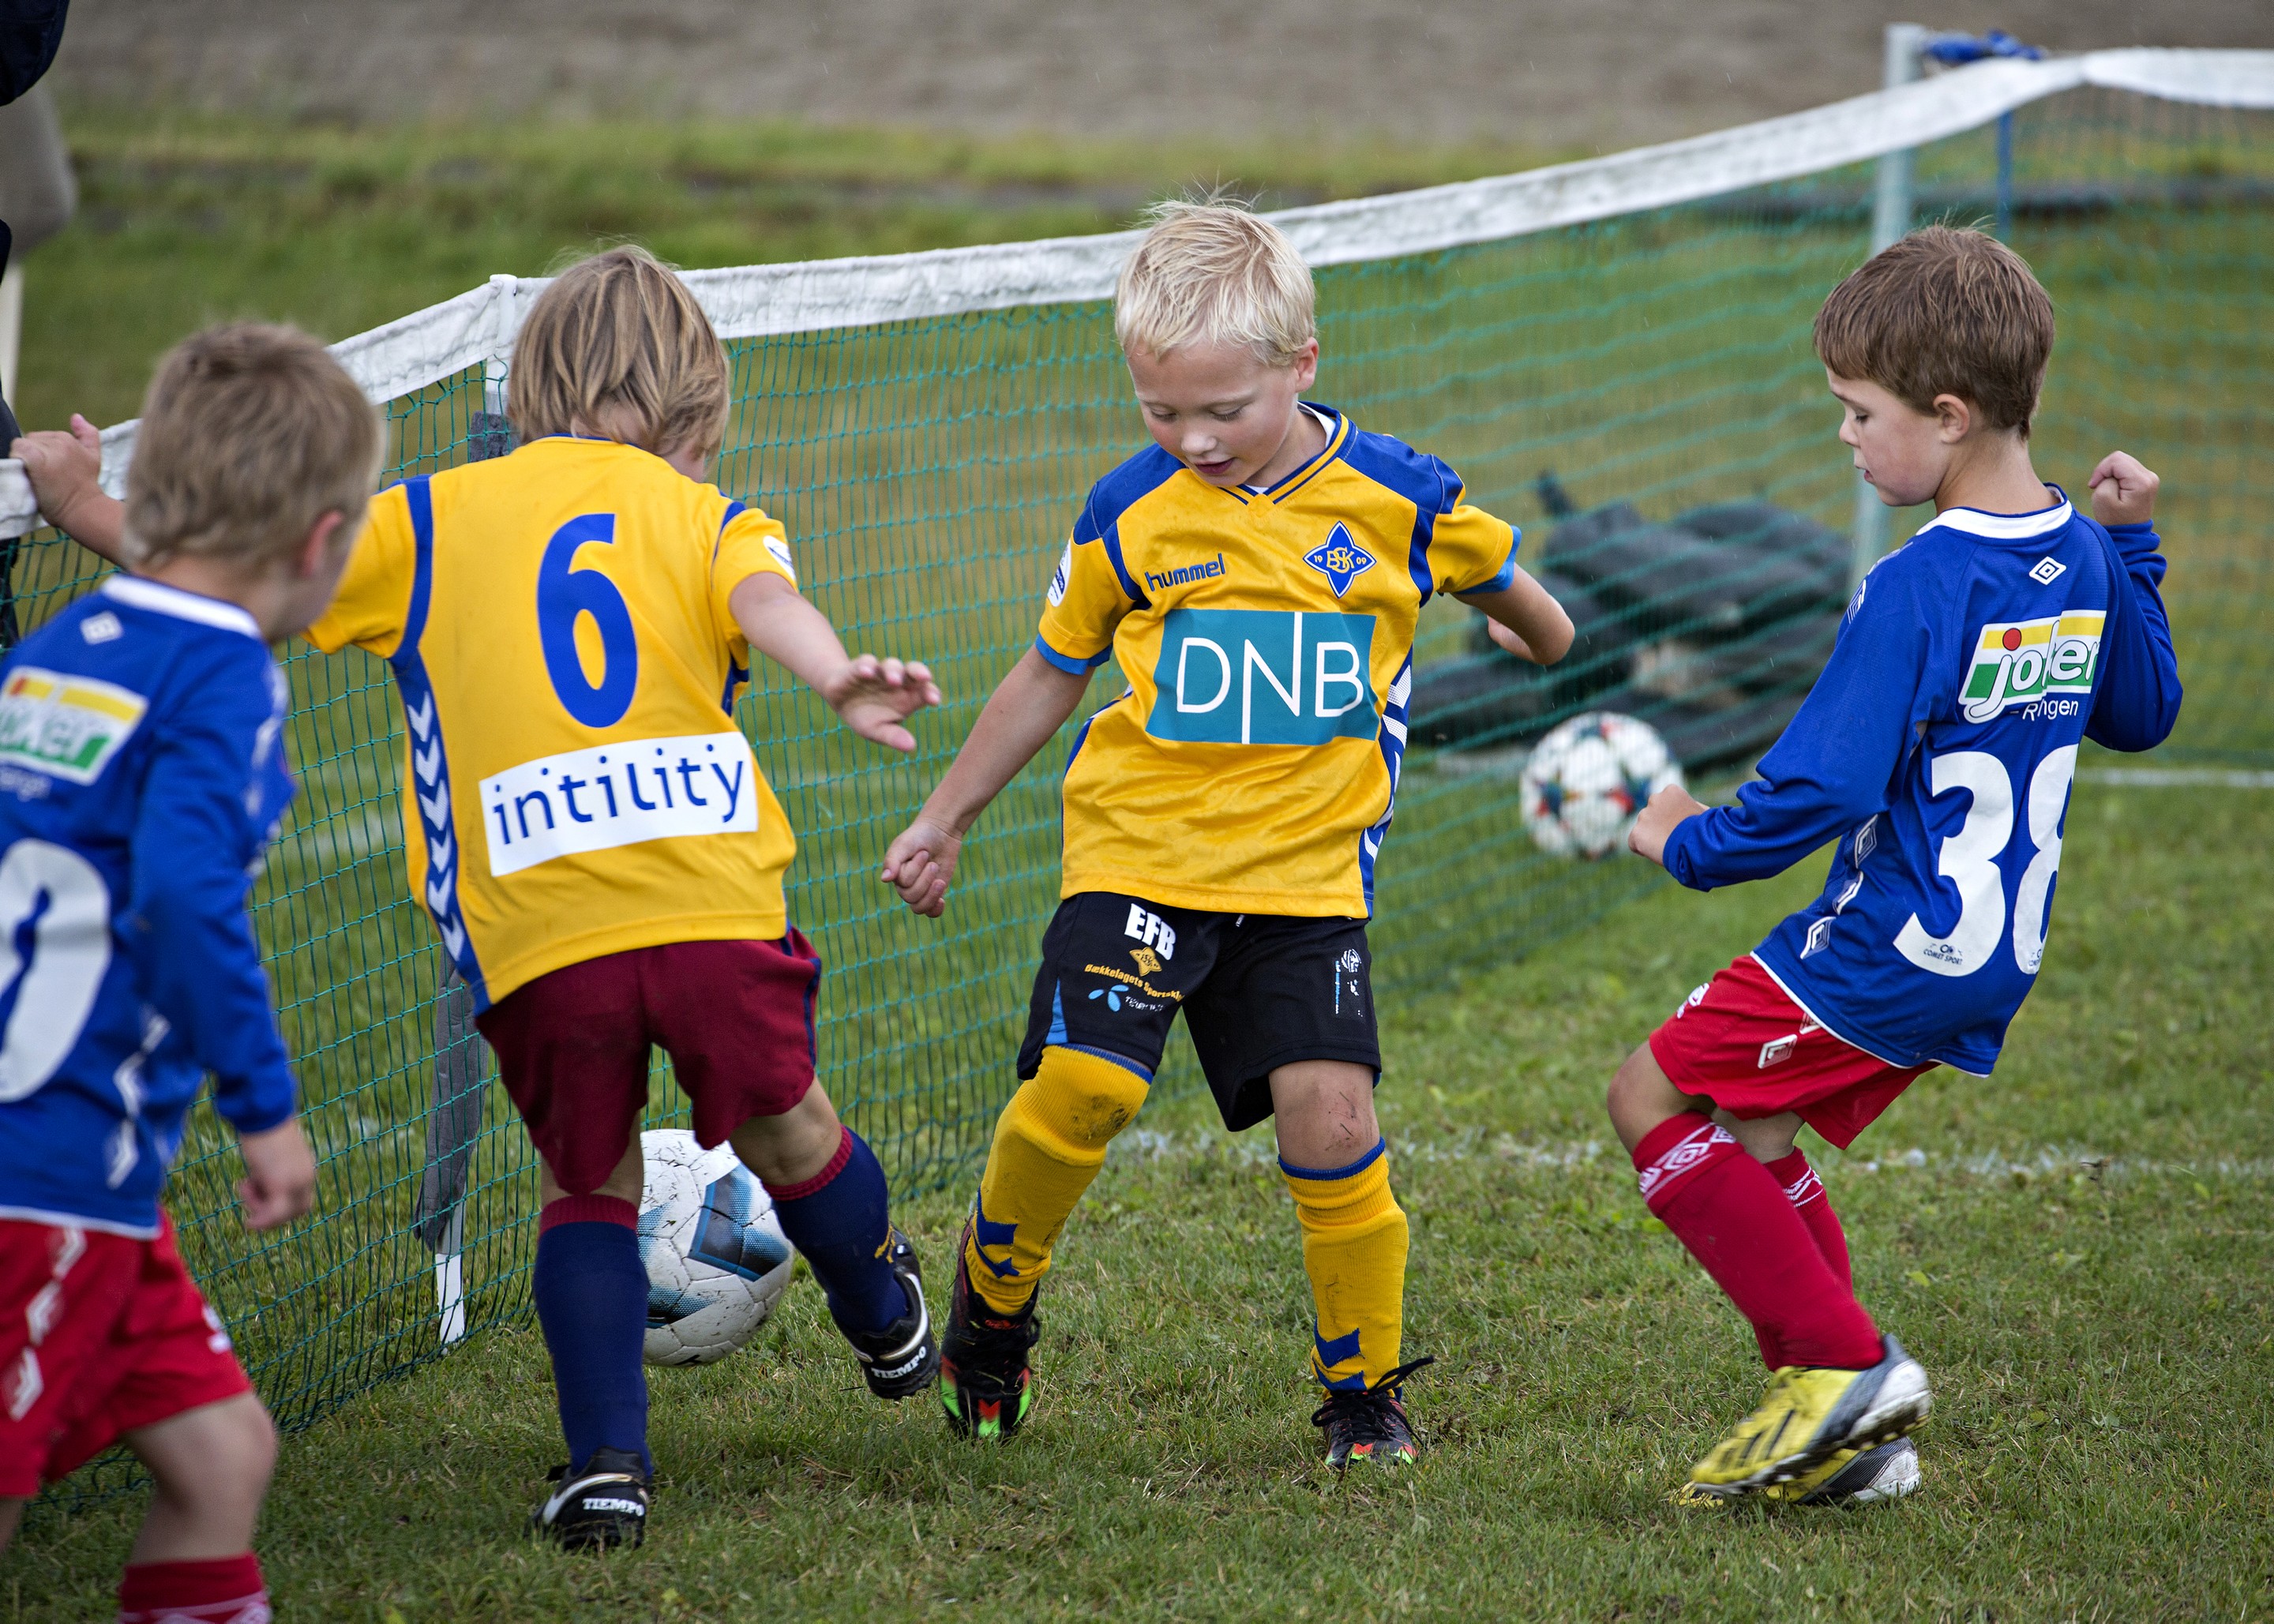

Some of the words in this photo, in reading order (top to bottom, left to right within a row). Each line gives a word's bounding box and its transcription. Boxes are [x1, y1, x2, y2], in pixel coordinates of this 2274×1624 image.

[1144, 552, 1225, 592] hummel
[537, 513, 638, 728] 6
[1176, 612, 1364, 744] DNB
[493, 744, 744, 846] intility
[1893, 743, 2081, 977] 38
[1124, 902, 1176, 961] EFB
[1945, 953, 1963, 966] SPORT
[871, 1345, 927, 1379] TIEMPO
[582, 1498, 645, 1517] TIEMPO
